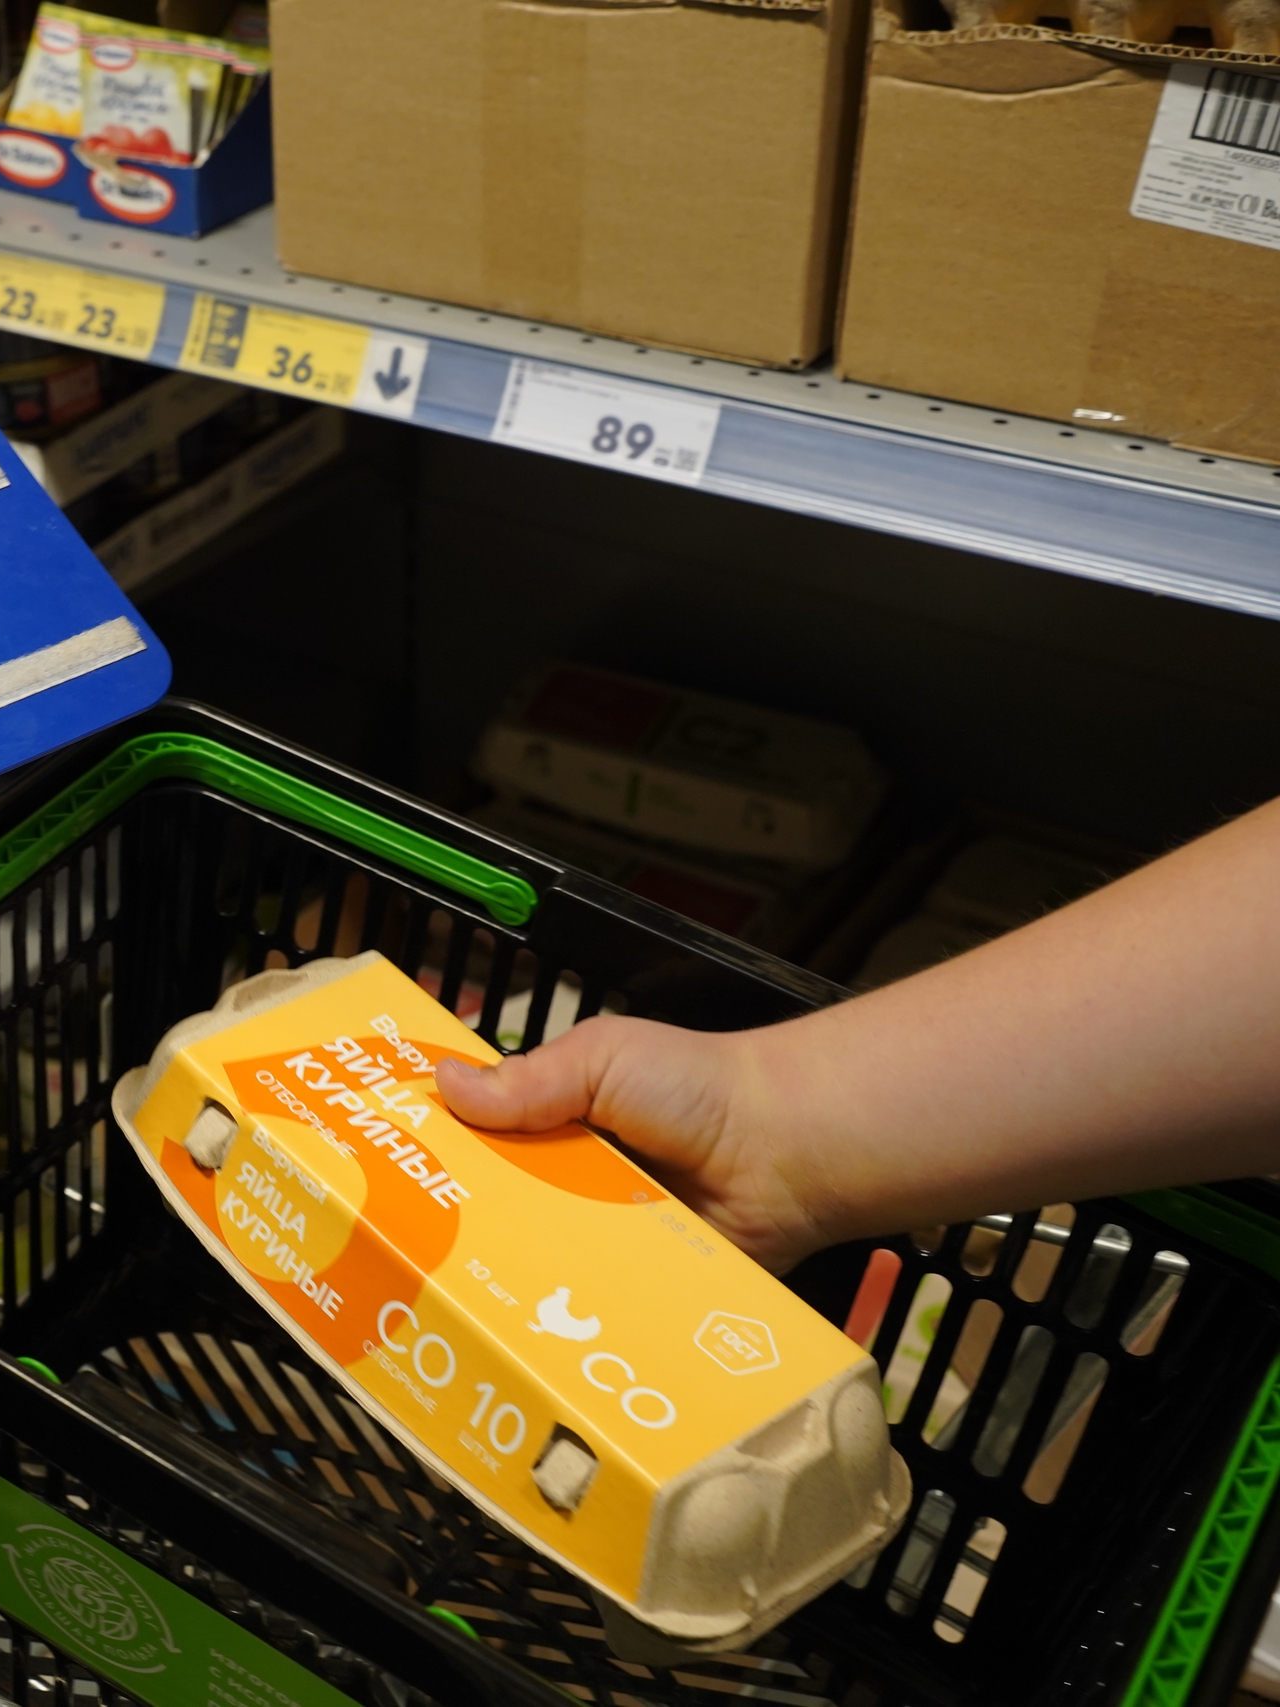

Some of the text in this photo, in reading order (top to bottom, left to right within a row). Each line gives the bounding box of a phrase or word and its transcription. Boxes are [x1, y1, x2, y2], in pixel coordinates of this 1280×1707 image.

[77, 302, 117, 339] 23
[267, 344, 313, 384] 36
[591, 415, 654, 460] 89
[369, 1013, 437, 1075] Выру
[255, 1070, 359, 1160] ОТБОРНЫЕ
[321, 1036, 431, 1129] ЯЙЦА
[284, 1051, 472, 1210] КУРИНЫЕ
[235, 1161, 306, 1244] ЯЙЦА
[220, 1189, 344, 1321] КУРИНЫЕ
[464, 1258, 492, 1281] 10
[711, 1323, 763, 1361] ГОСТ
[468, 1382, 527, 1455] 10
